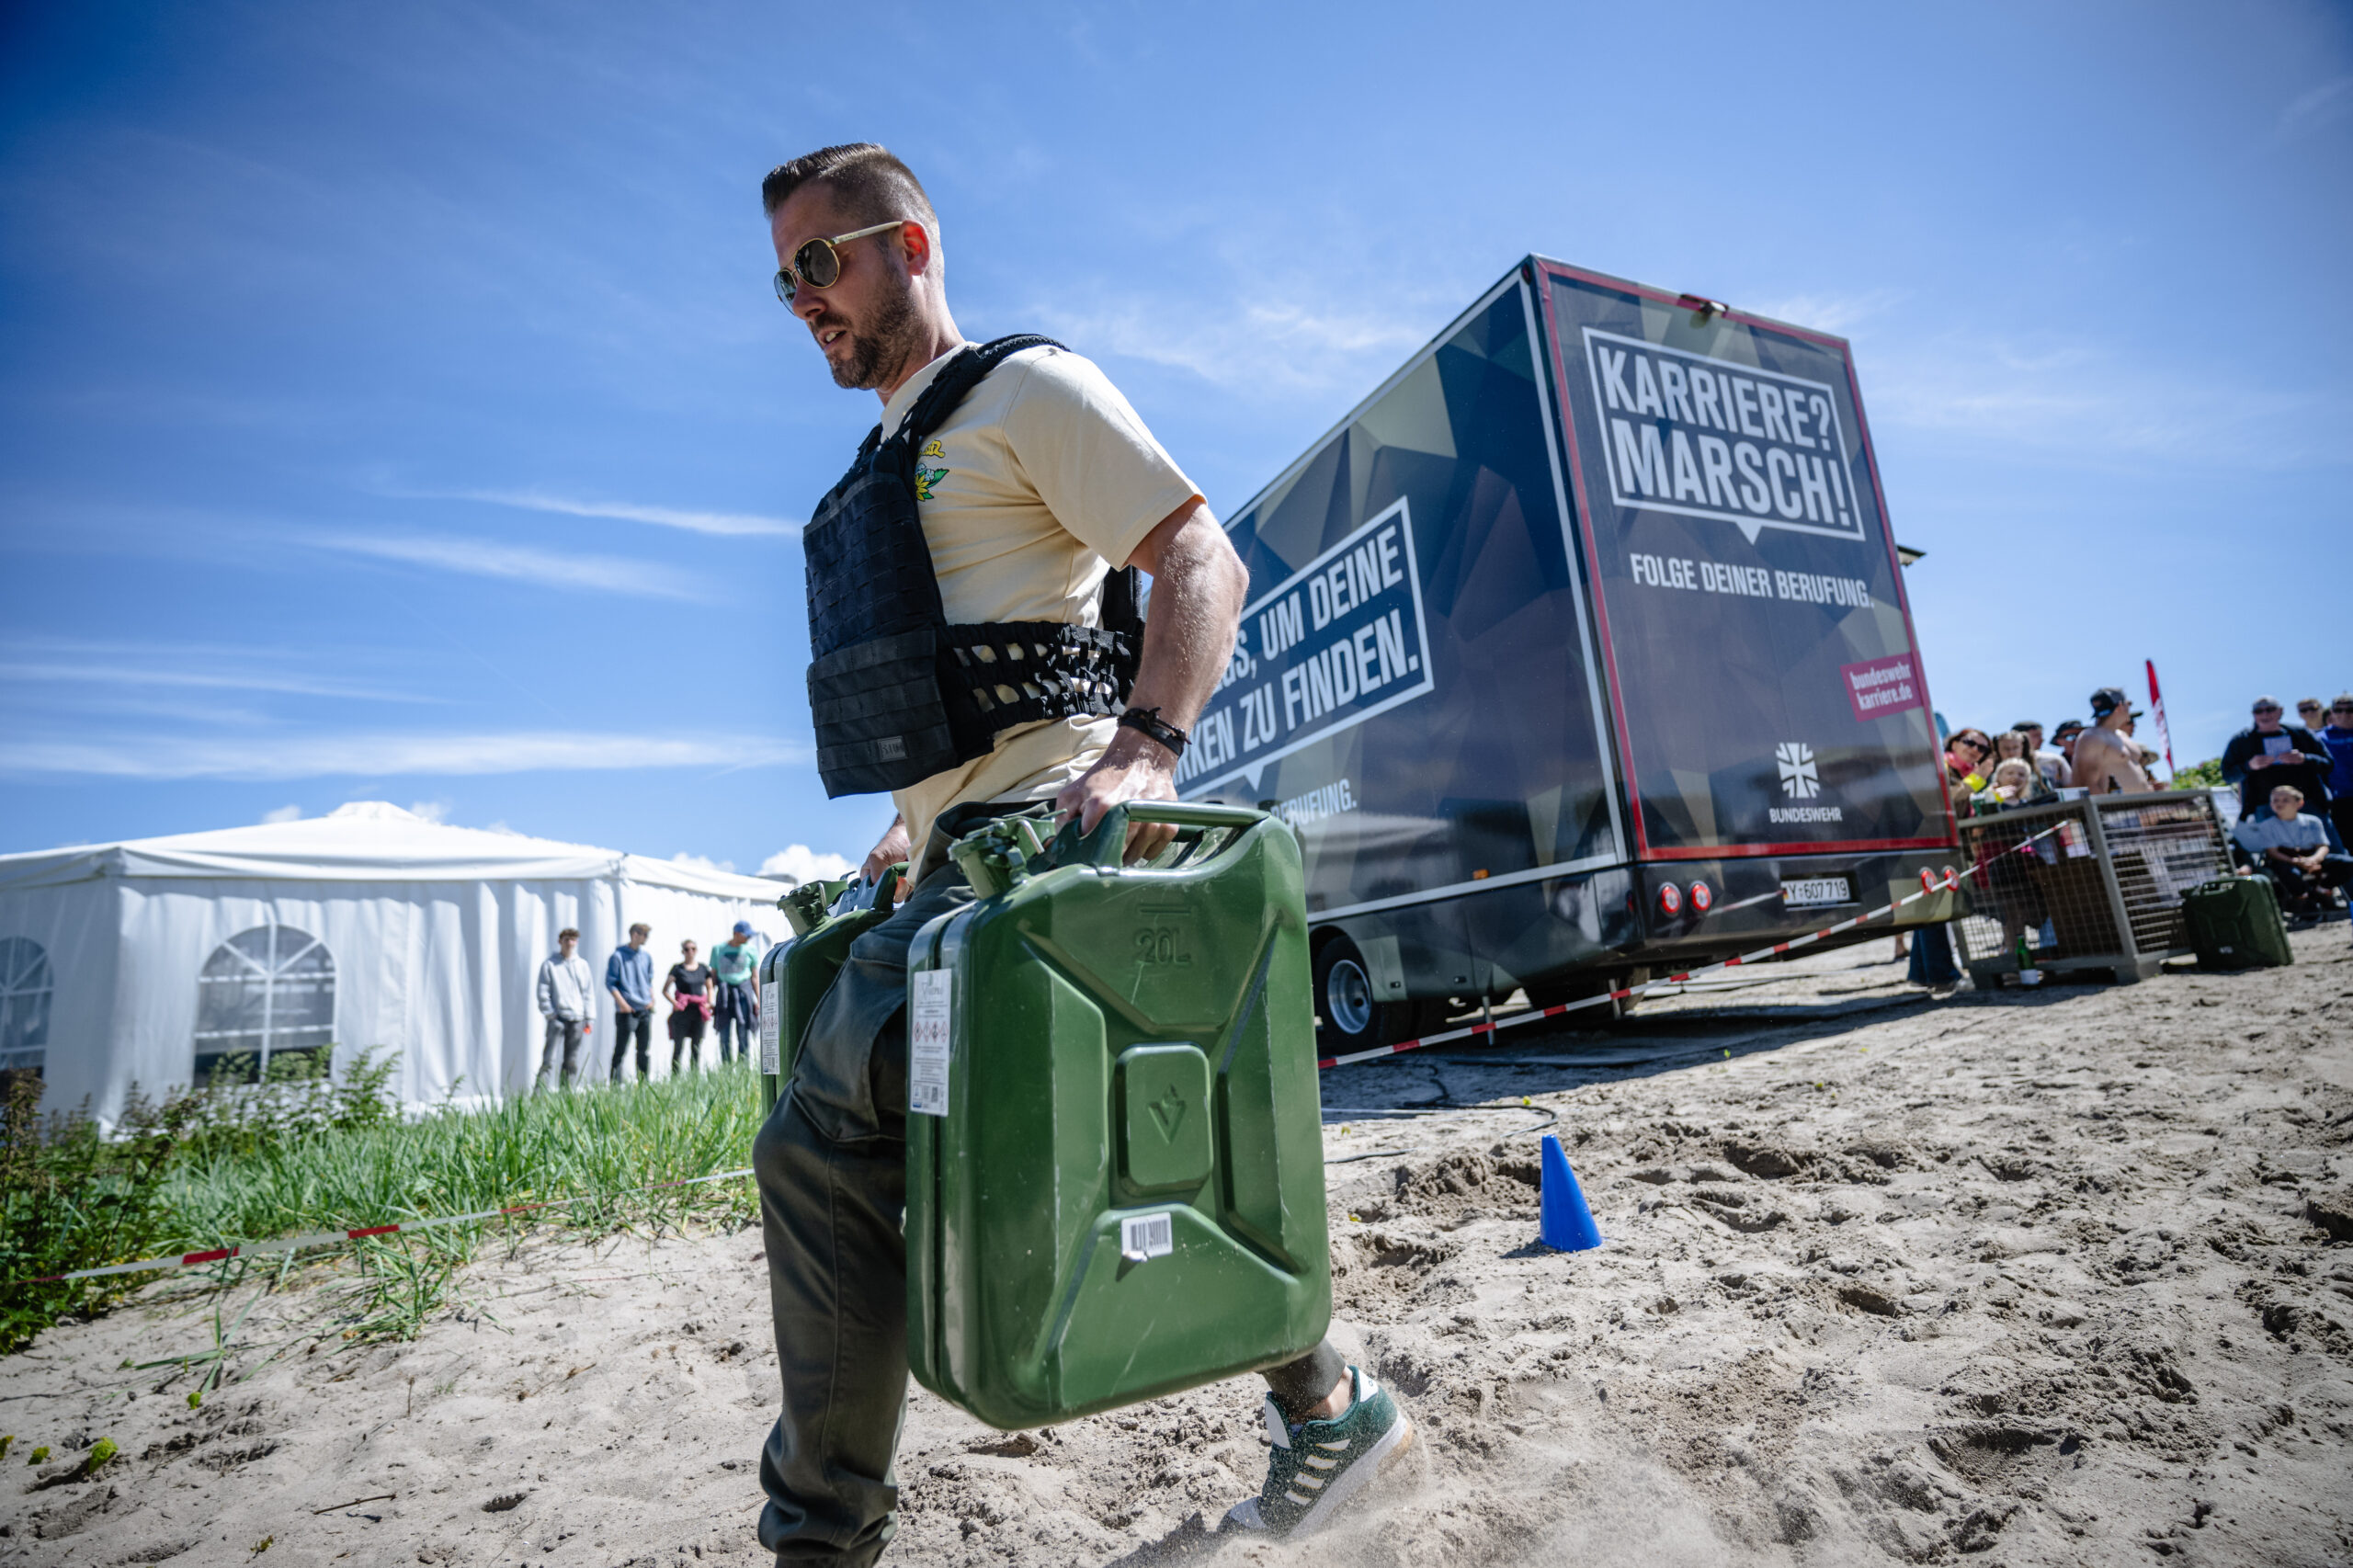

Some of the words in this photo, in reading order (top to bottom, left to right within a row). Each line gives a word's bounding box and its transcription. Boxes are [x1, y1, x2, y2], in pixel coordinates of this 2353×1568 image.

[1597, 346, 1832, 451] KARRIERE?
[1610, 417, 1851, 527] MARSCH!
[1259, 591, 1305, 661] UM
[1308, 525, 1404, 631] DEINE
[1630, 553, 1699, 590] FOLGE
[1699, 562, 1773, 597] DEINER
[1774, 570, 1875, 608] BERUFUNG.
[1173, 705, 1236, 787] RKEN
[1239, 682, 1278, 753] ZU
[1281, 608, 1418, 731] FINDEN.
[1849, 661, 1912, 690] bundeswehr
[1856, 682, 1914, 711] karriere.de
[1768, 806, 1843, 824] BUNDESWEHR
[1133, 926, 1192, 966] 20L
